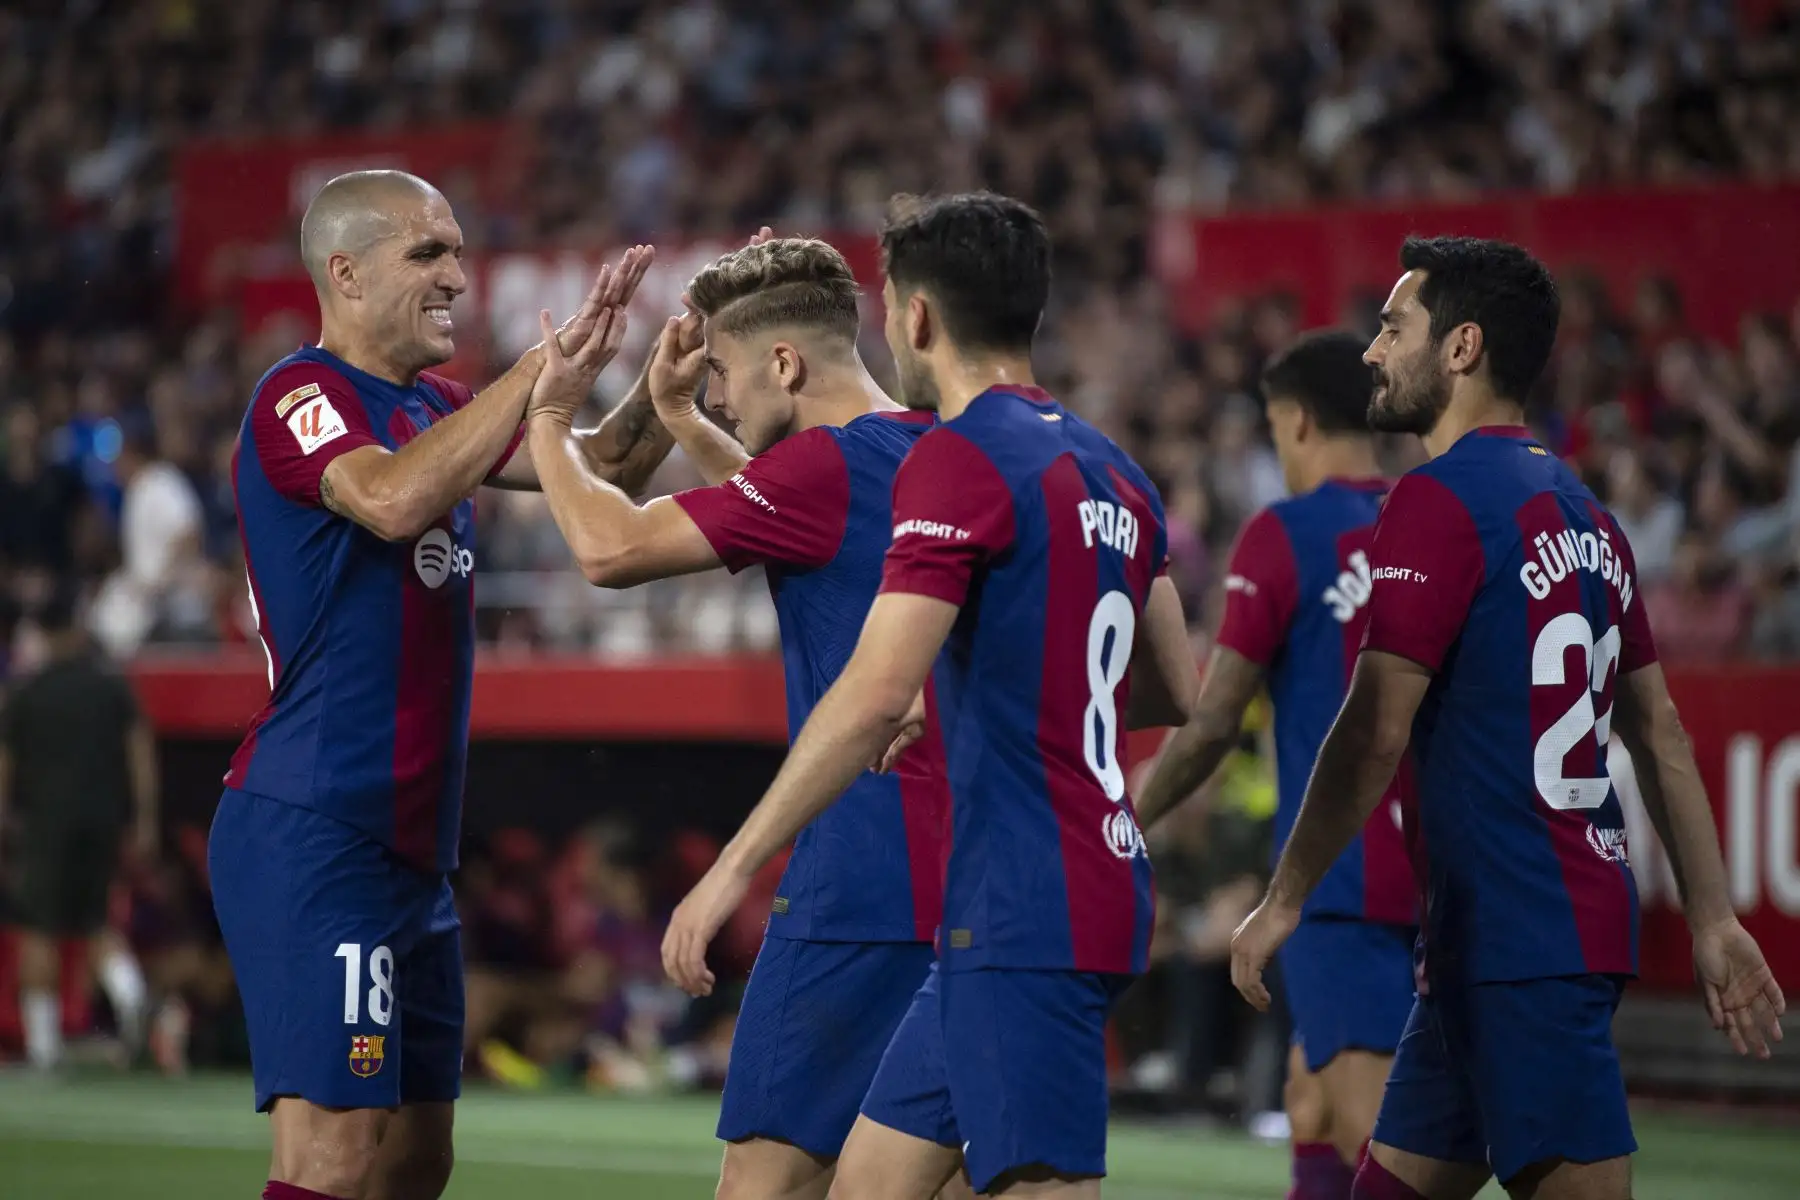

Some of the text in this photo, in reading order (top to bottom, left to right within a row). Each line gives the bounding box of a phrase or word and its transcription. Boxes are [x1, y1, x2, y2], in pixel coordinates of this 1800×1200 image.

[1413, 571, 1428, 583] tv
[1083, 590, 1135, 802] 8
[334, 943, 394, 1026] 18
